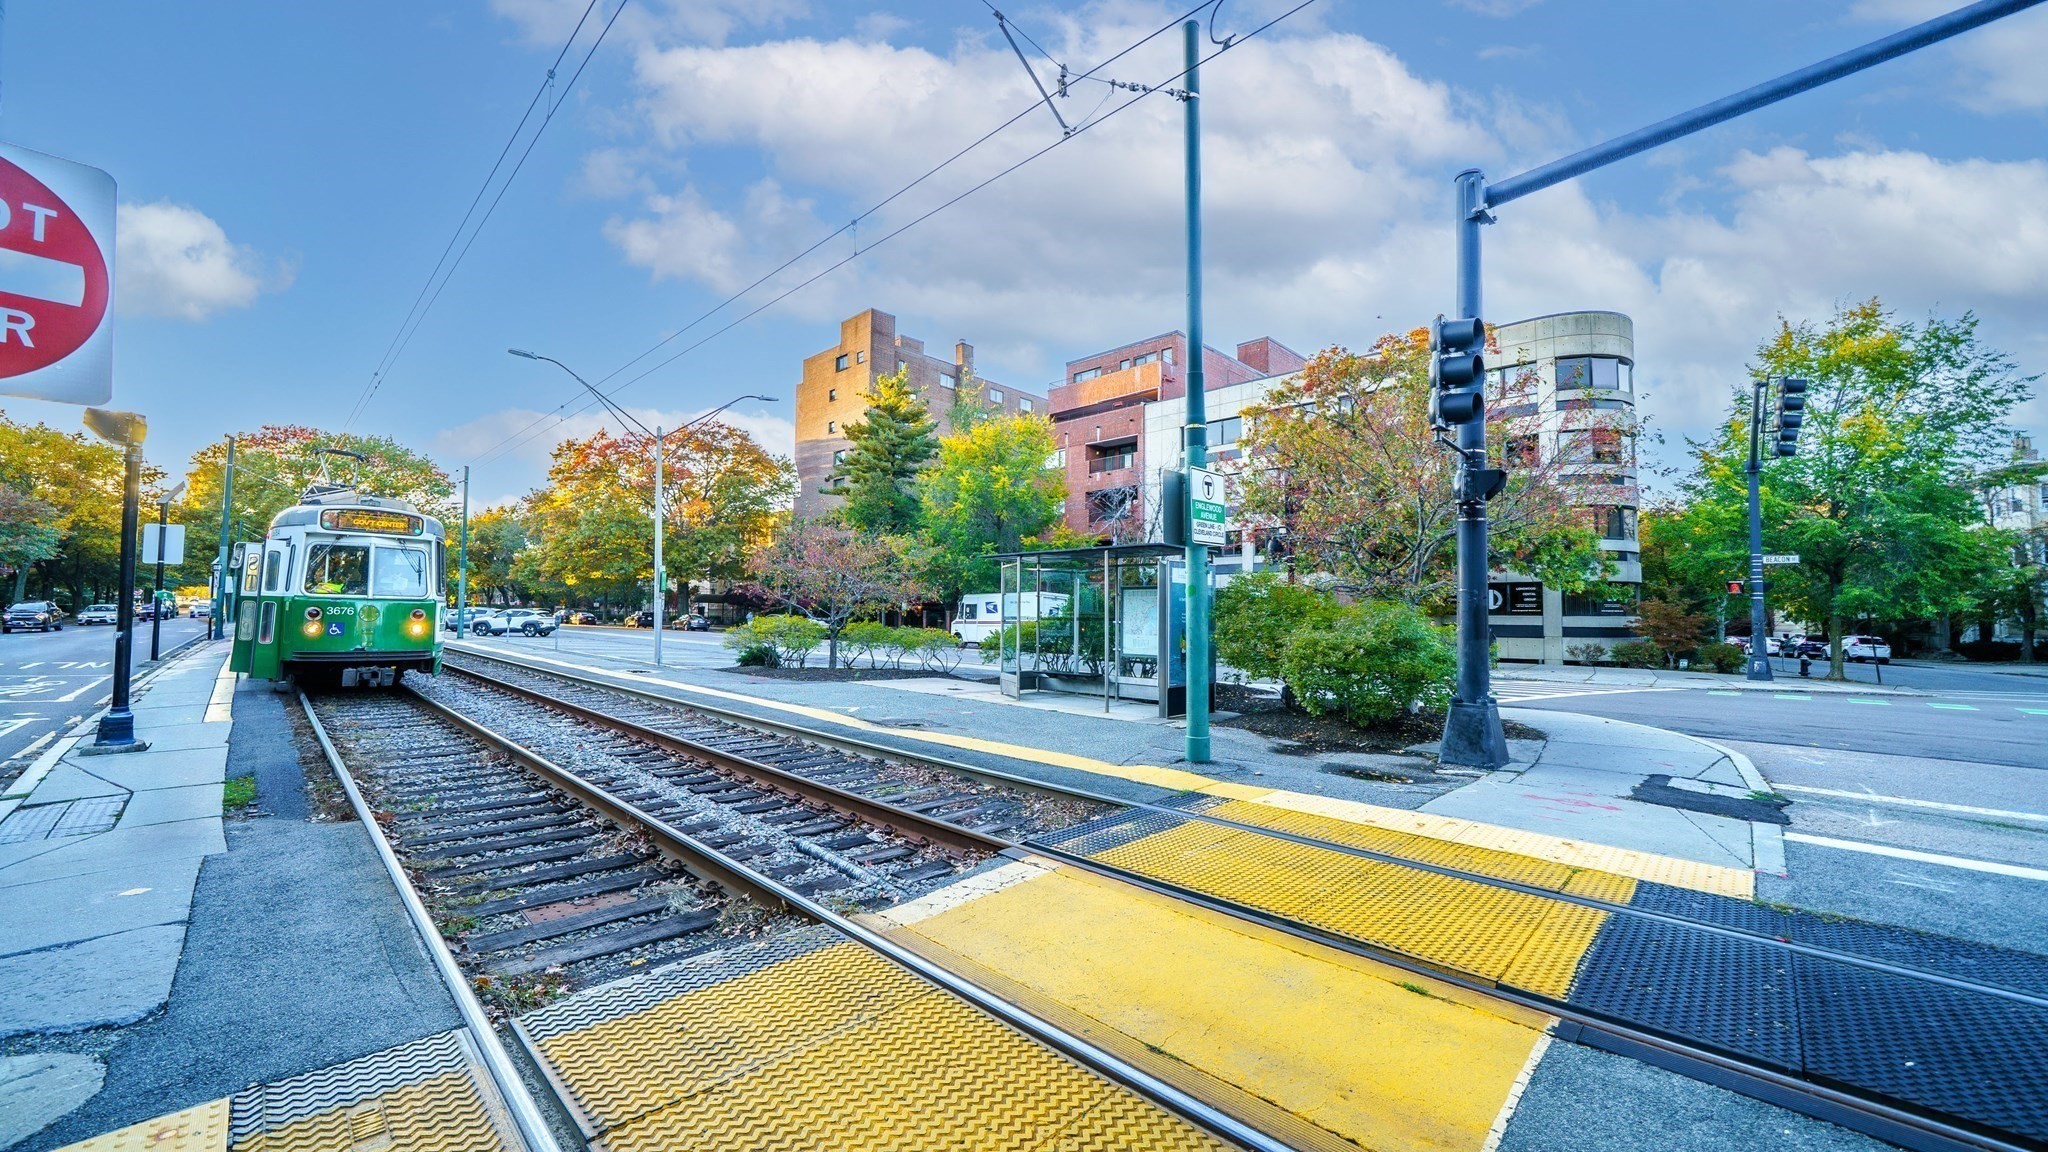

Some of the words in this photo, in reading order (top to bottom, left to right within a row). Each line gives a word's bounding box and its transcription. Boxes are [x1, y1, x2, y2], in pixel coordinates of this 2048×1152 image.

[1196, 502, 1222, 512] ENGLEWOOD
[1200, 512, 1217, 520] AVENUE
[376, 520, 405, 529] CENTER
[326, 606, 354, 616] 3676
